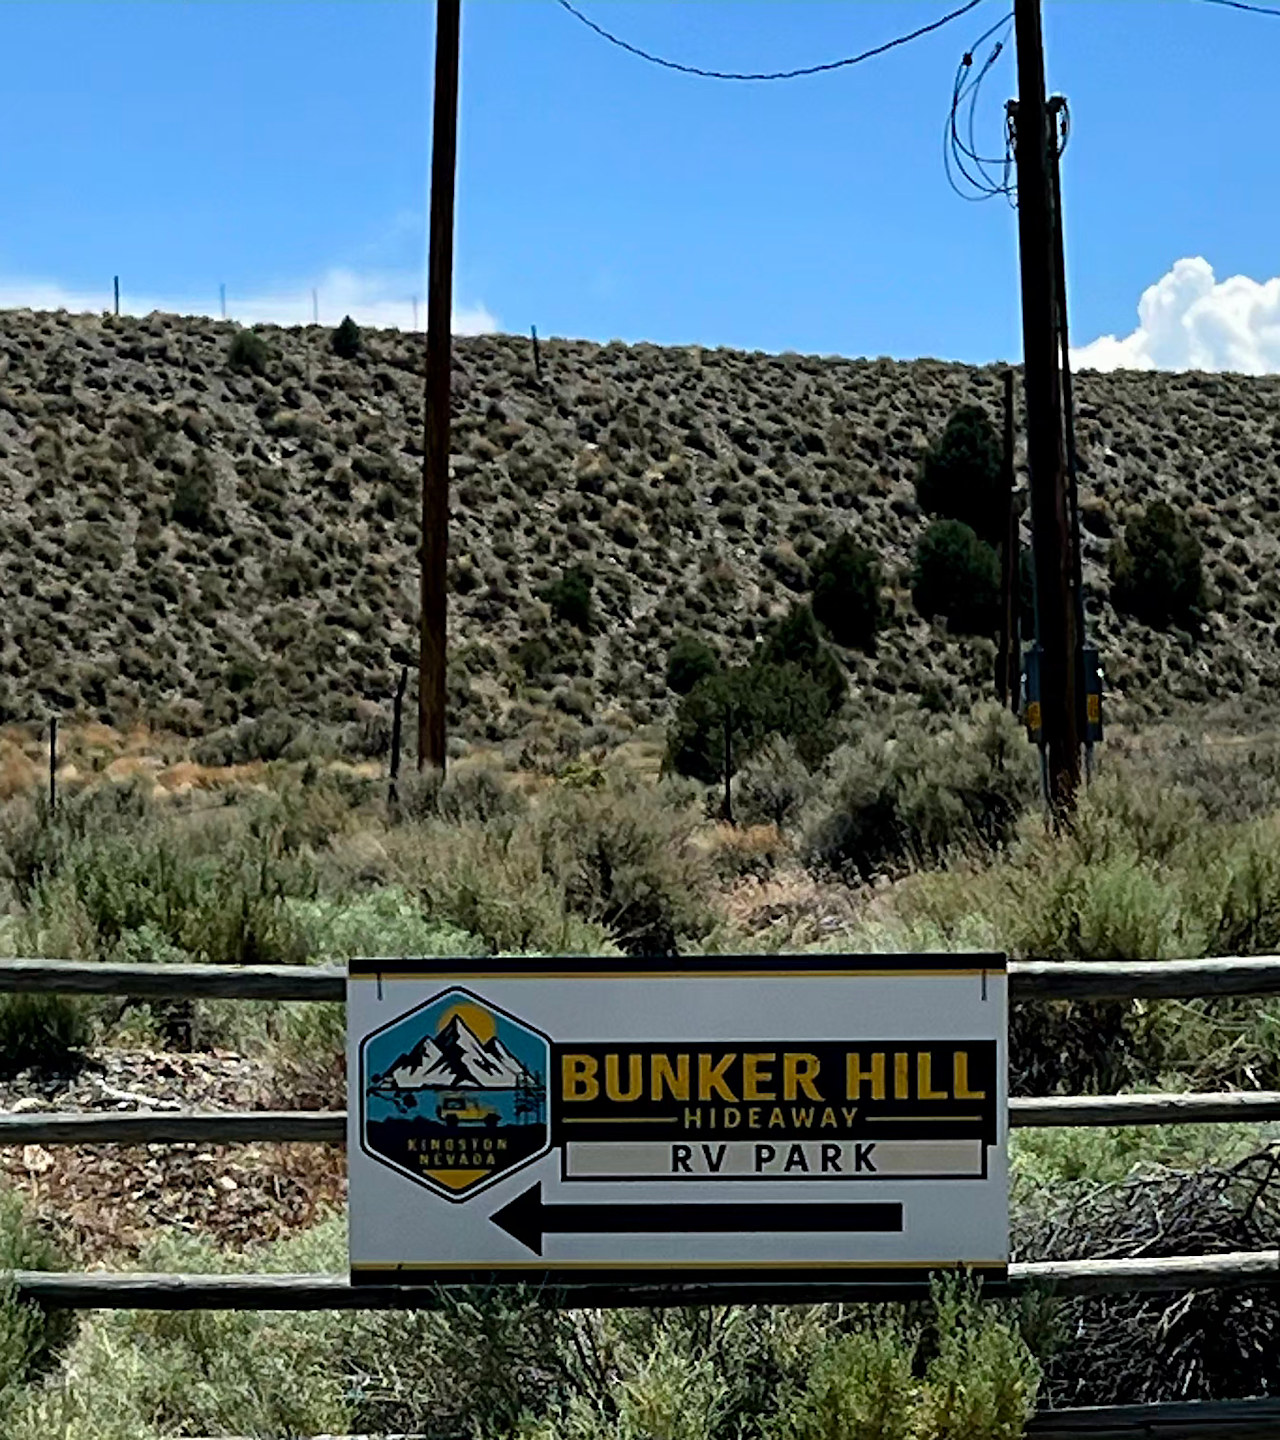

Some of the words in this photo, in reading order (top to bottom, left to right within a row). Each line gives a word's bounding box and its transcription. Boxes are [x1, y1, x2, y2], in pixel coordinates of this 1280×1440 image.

[561, 1052, 826, 1102] BUNKER
[846, 1051, 987, 1100] HILL
[684, 1107, 859, 1129] HIDEAWAY
[407, 1138, 508, 1151] KINGSTON
[419, 1153, 496, 1166] NEVADA
[671, 1144, 727, 1172] RV
[754, 1143, 878, 1172] PARK
